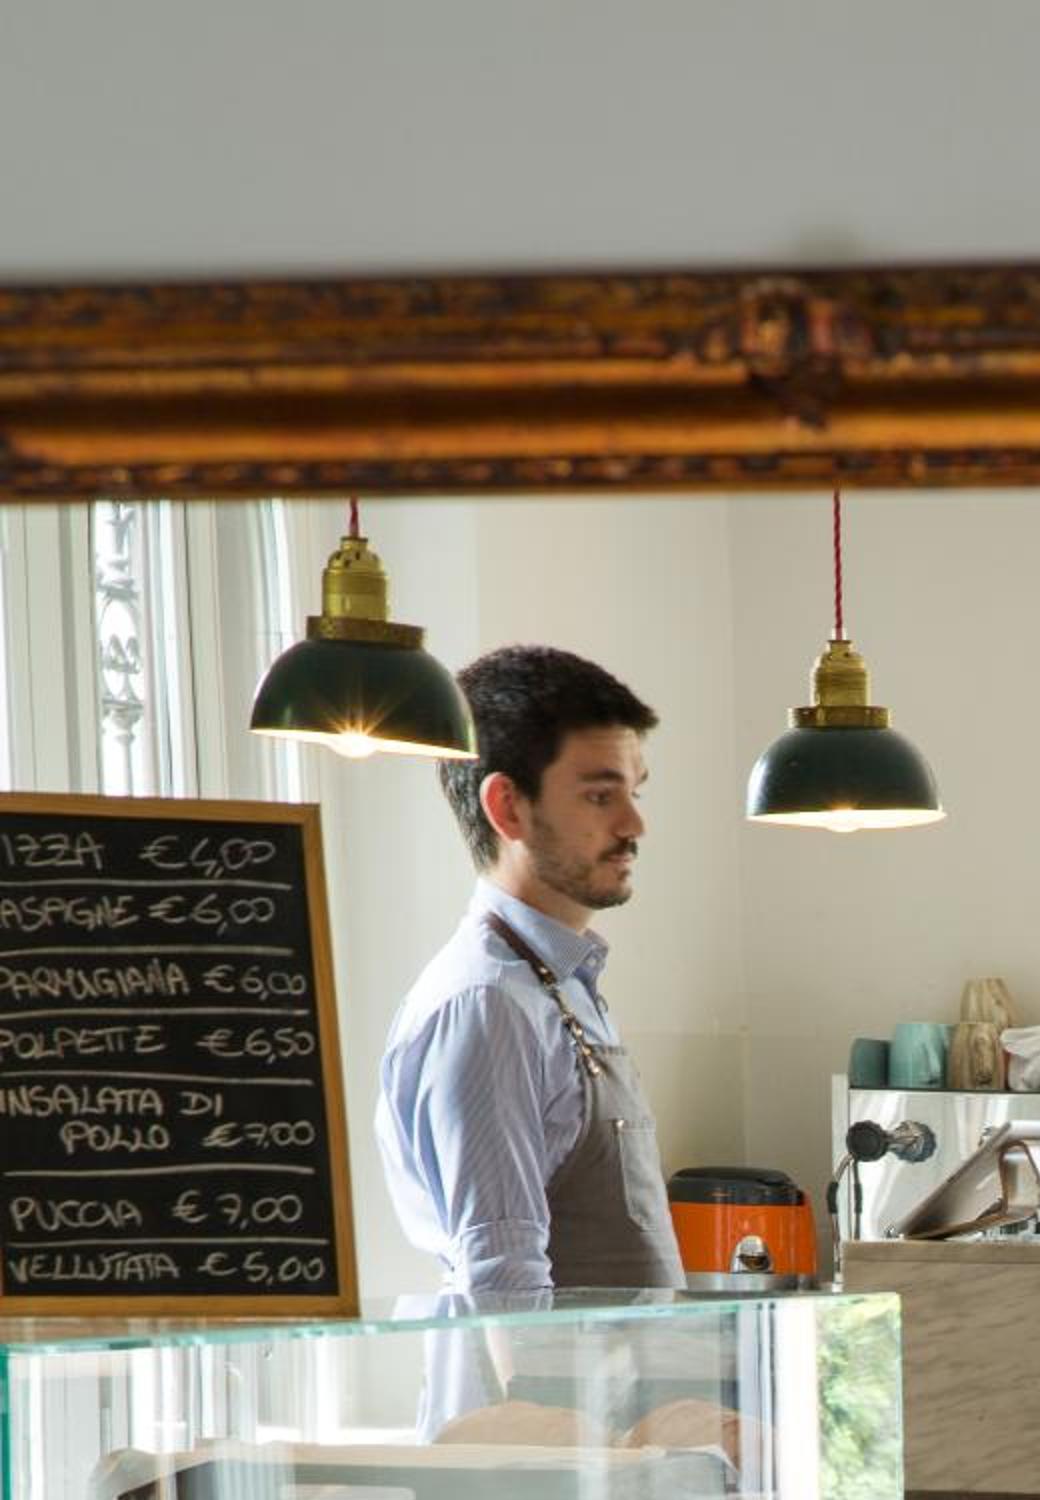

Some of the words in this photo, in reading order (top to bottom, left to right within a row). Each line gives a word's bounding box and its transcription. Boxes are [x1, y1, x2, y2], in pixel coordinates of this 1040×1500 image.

[3, 833, 102, 869] IZZA
[0, 896, 138, 931] ASAGNE
[149, 894, 274, 932] €6,00
[204, 965, 306, 1000] €6,00
[0, 1026, 164, 1060] POLPETTE
[197, 1028, 314, 1063] €6,50
[0, 1085, 163, 1116] INSALATA
[181, 1092, 222, 1116] DI
[60, 1121, 169, 1153] POLLO
[203, 1121, 314, 1147] €7,00
[10, 1197, 141, 1231] PUCCIA
[173, 1190, 302, 1228] €7,00
[9, 1252, 179, 1282] VELLUTATA
[198, 1252, 324, 1284] €5,00
